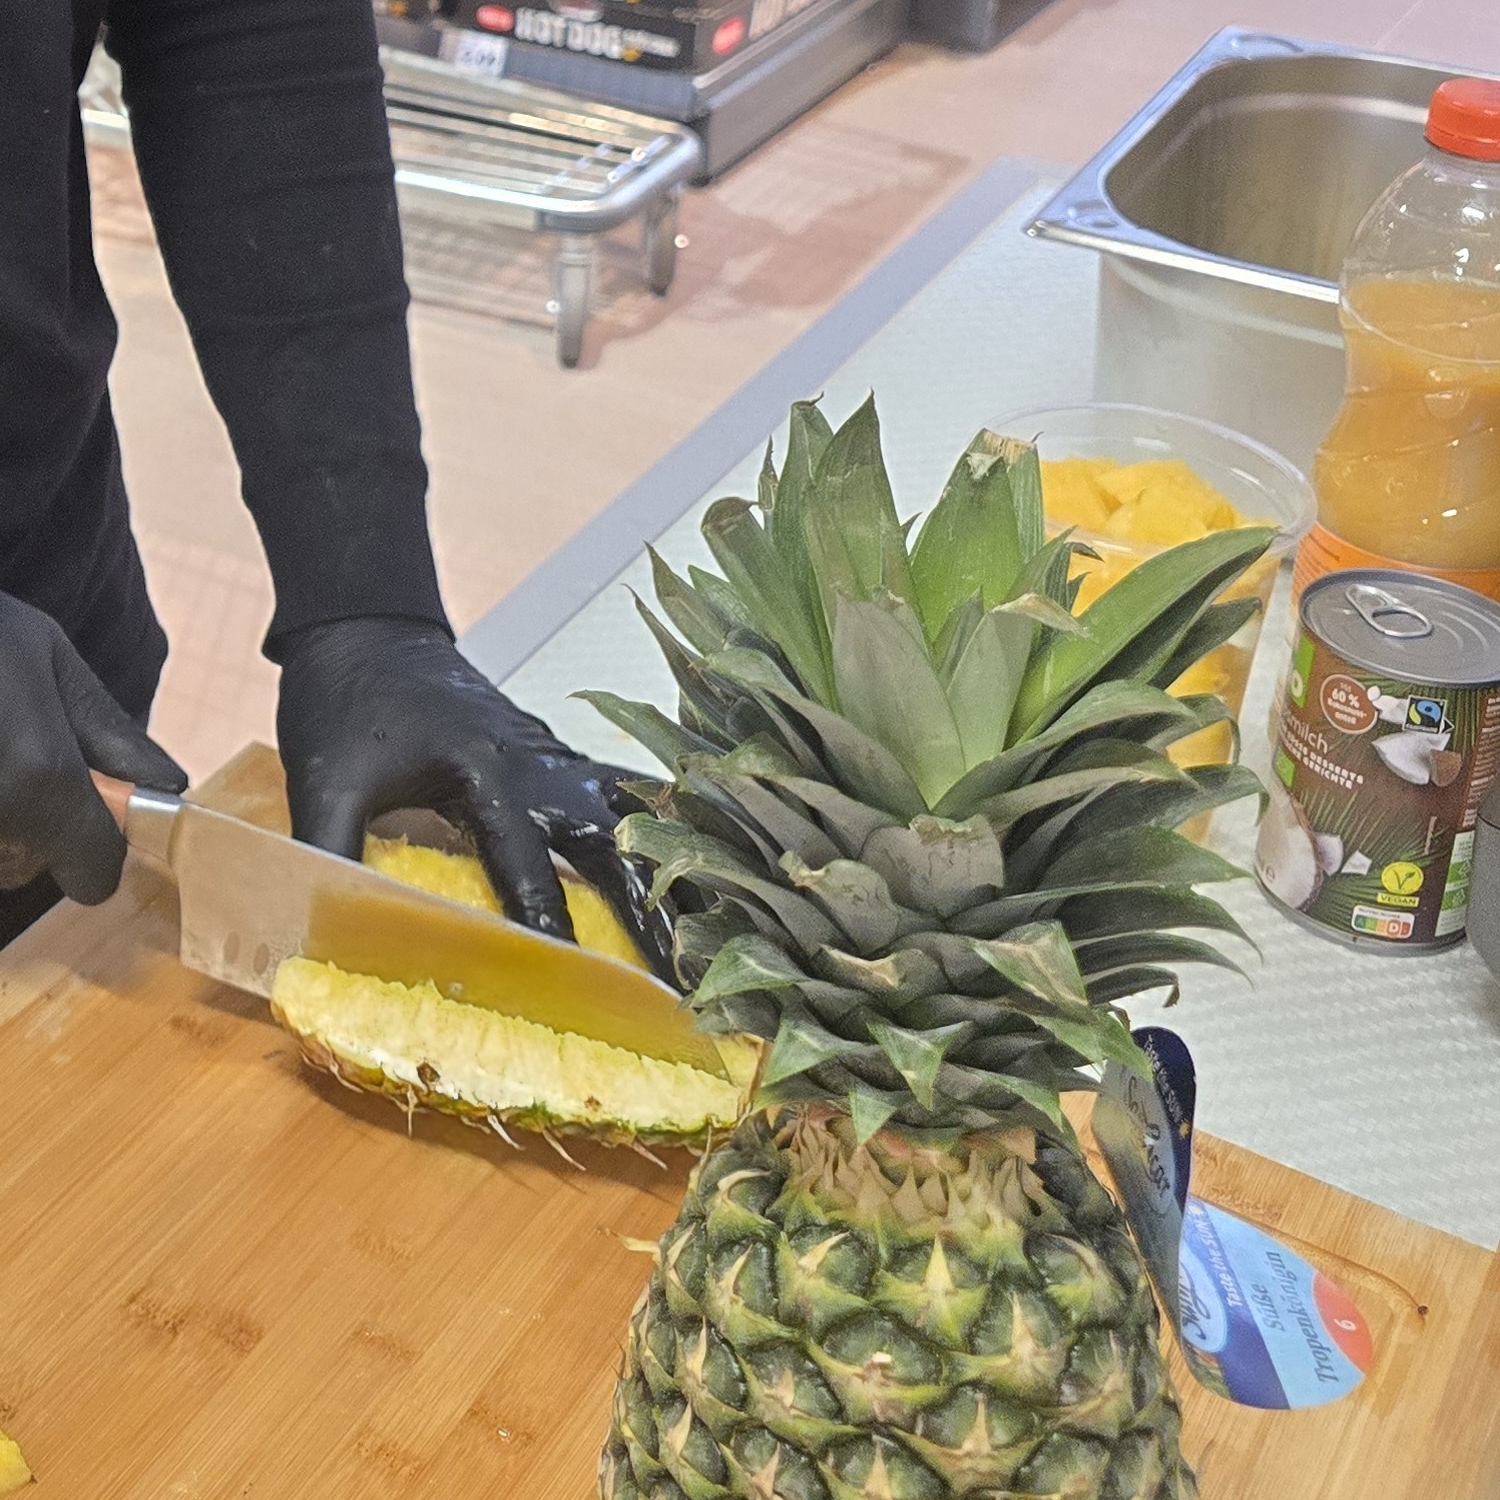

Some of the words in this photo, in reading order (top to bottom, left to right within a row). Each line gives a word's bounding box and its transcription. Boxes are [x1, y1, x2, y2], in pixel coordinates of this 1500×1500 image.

[515, 6, 567, 48] HOT
[567, 20, 624, 60] DOG
[1332, 688, 1346, 703] 60
[1380, 894, 1418, 906] VEGAN
[1194, 1218, 1218, 1250] SUN
[1251, 1283, 1285, 1333] Süße
[1266, 1251, 1339, 1383] Tropenkönigin
